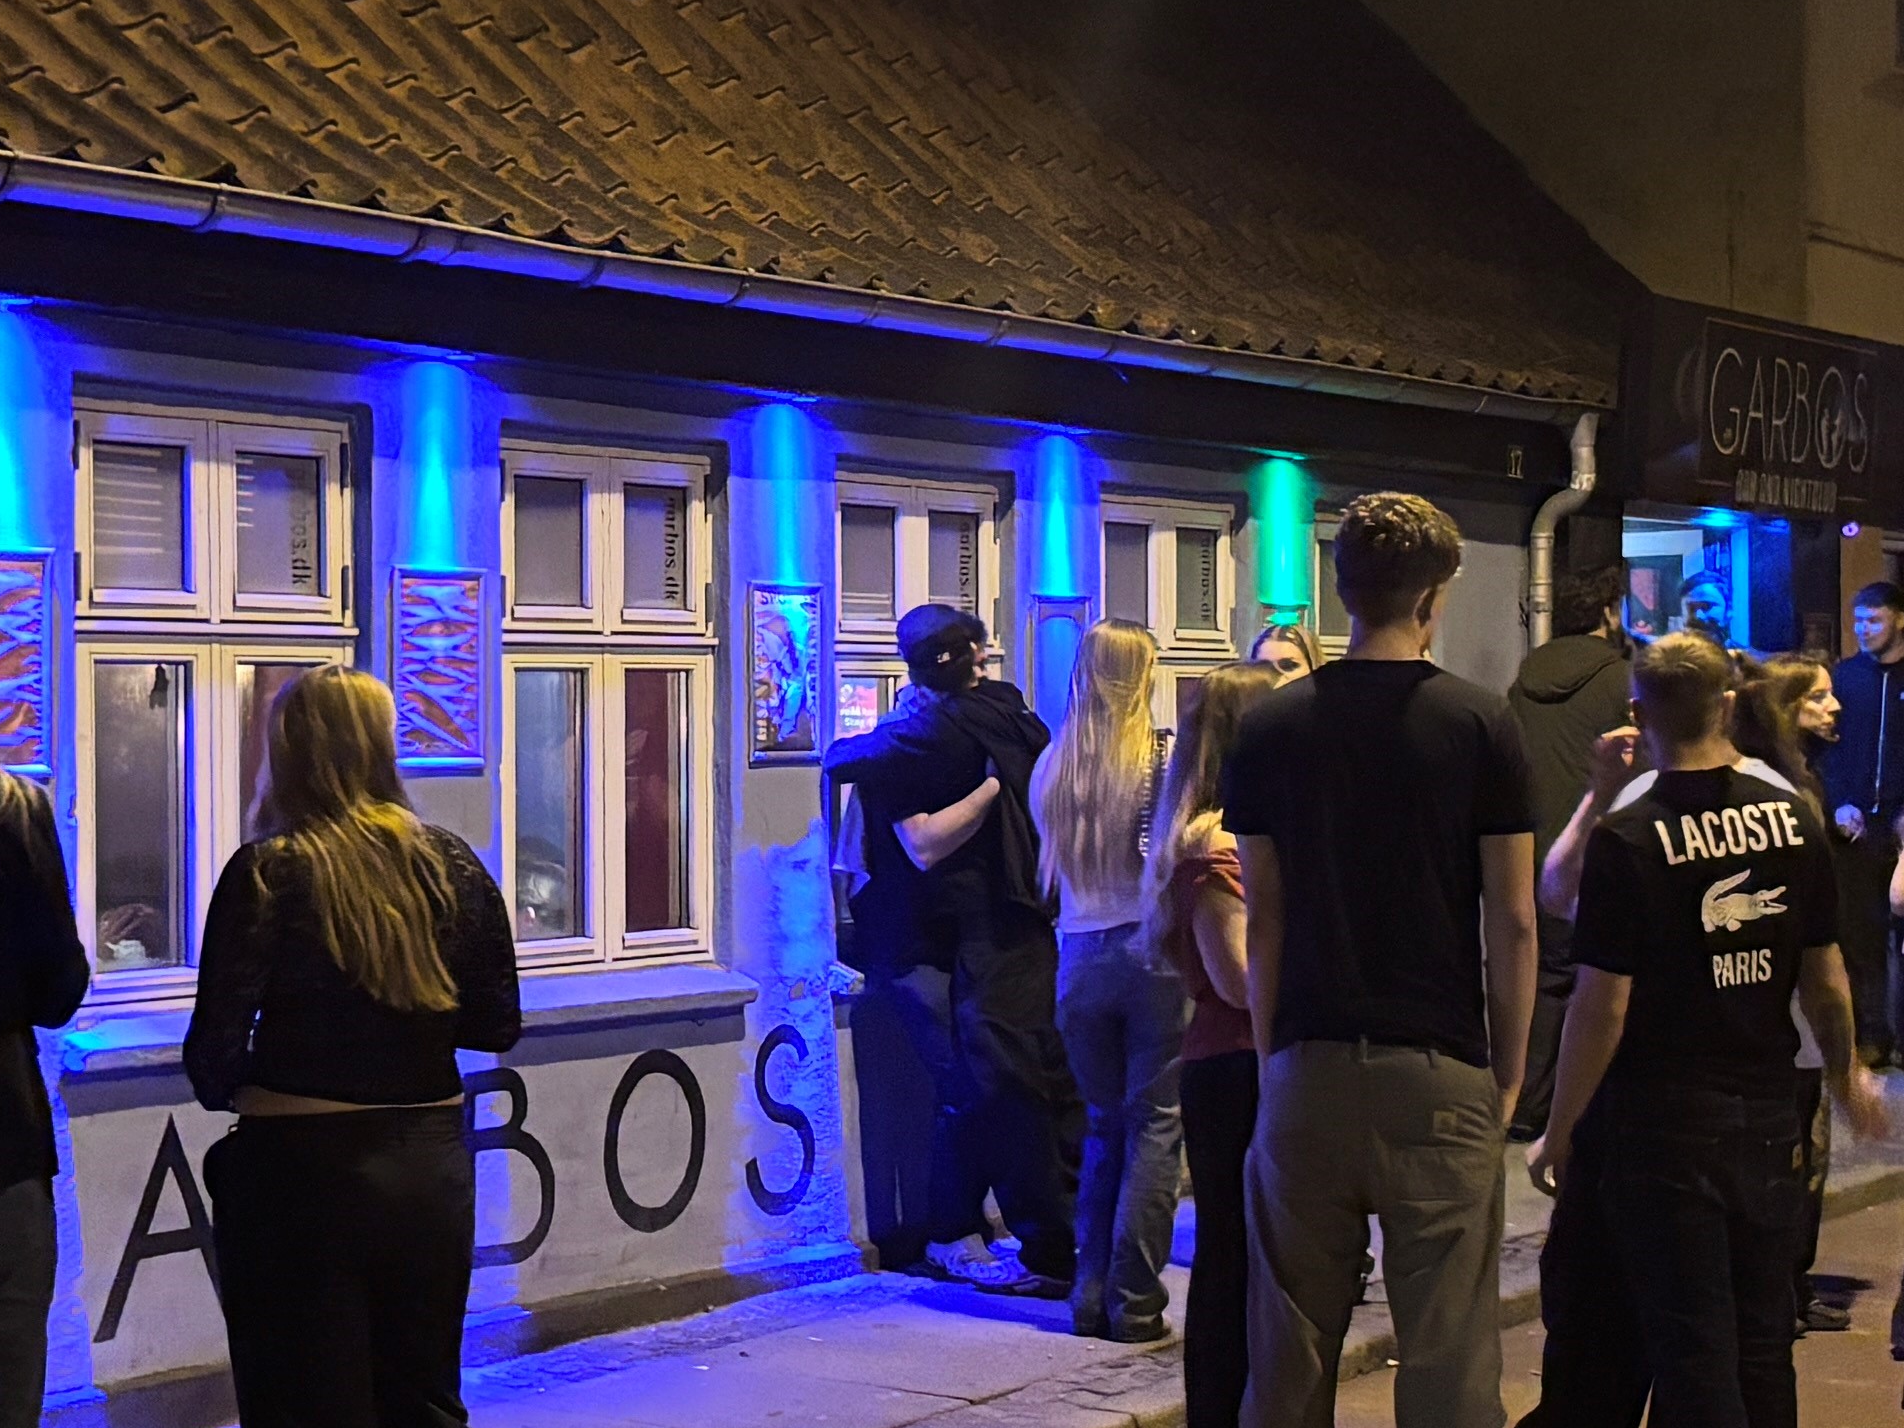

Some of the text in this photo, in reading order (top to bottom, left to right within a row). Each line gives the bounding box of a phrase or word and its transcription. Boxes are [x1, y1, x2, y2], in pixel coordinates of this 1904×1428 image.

[1709, 347, 1868, 473] GARBOS
[1654, 801, 1804, 865] LACOSTE
[1712, 948, 1772, 989] PARIS
[93, 1024, 815, 1344] ABOS
